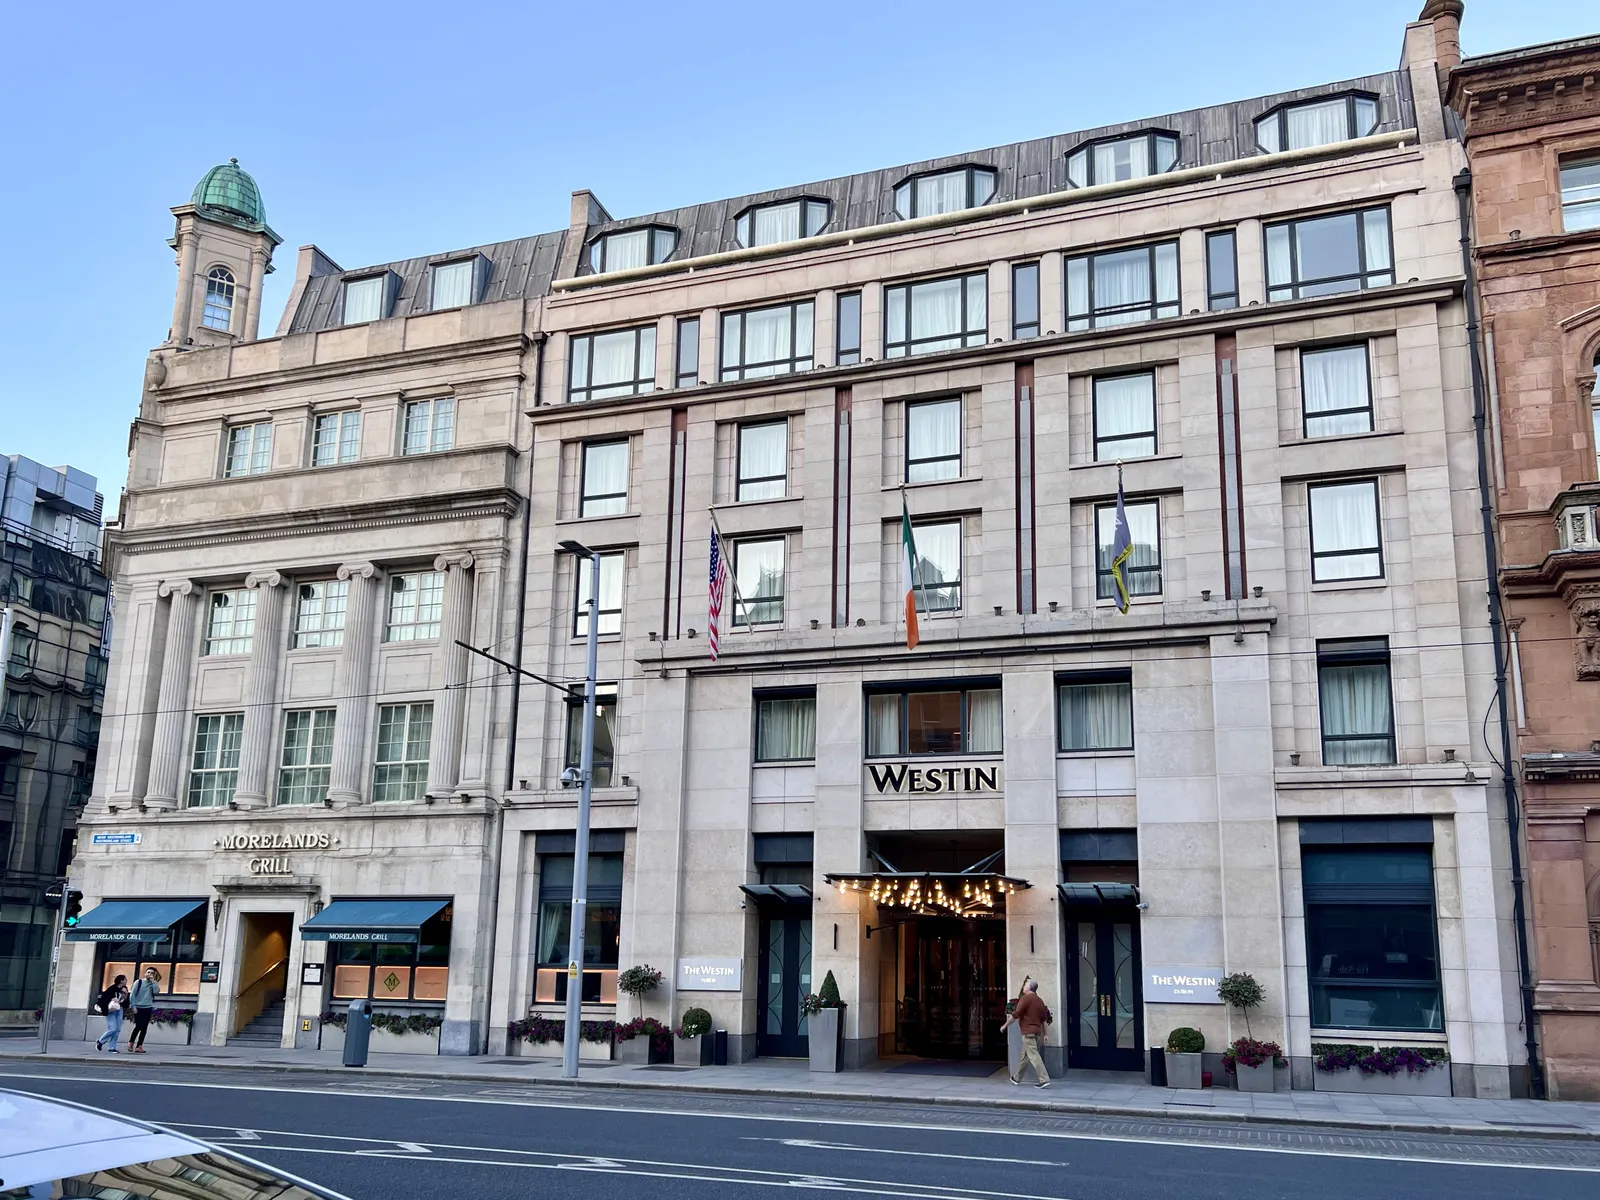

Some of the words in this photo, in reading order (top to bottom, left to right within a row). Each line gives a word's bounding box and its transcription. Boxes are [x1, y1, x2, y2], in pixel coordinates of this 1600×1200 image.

[868, 764, 998, 793] WESTIN
[221, 833, 330, 849] MORELANDS
[249, 858, 292, 873] GRILL
[683, 965, 700, 975] THE
[700, 965, 734, 976] WESTIN
[1152, 974, 1173, 985] THE
[1172, 975, 1216, 986] WESTIN
